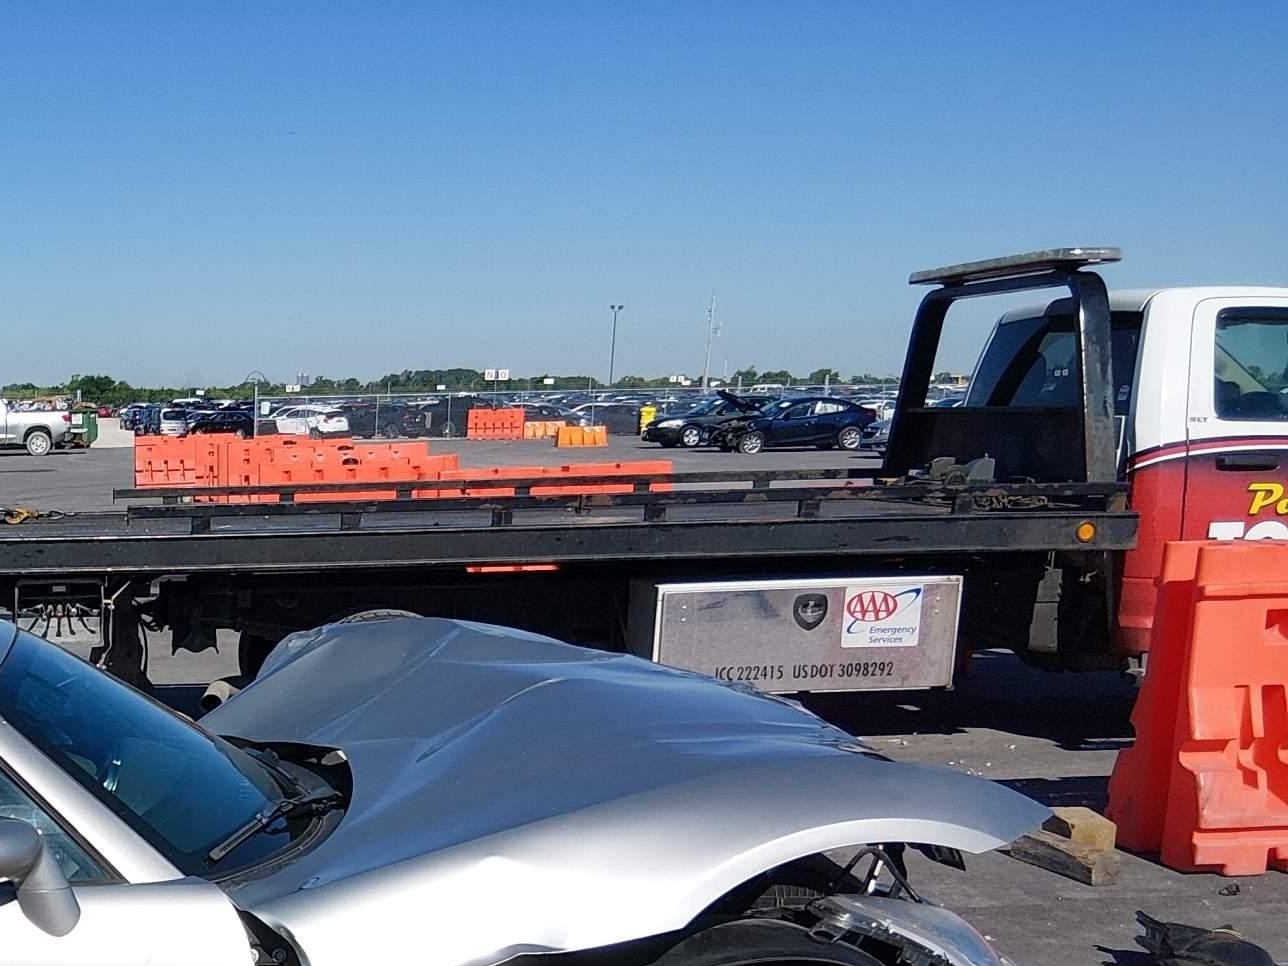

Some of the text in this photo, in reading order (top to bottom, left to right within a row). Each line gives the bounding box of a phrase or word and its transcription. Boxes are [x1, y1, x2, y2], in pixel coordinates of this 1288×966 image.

[851, 591, 894, 621] AAA
[869, 626, 917, 635] Emergency
[737, 665, 784, 680] 222415
[838, 661, 894, 677] 3098292
